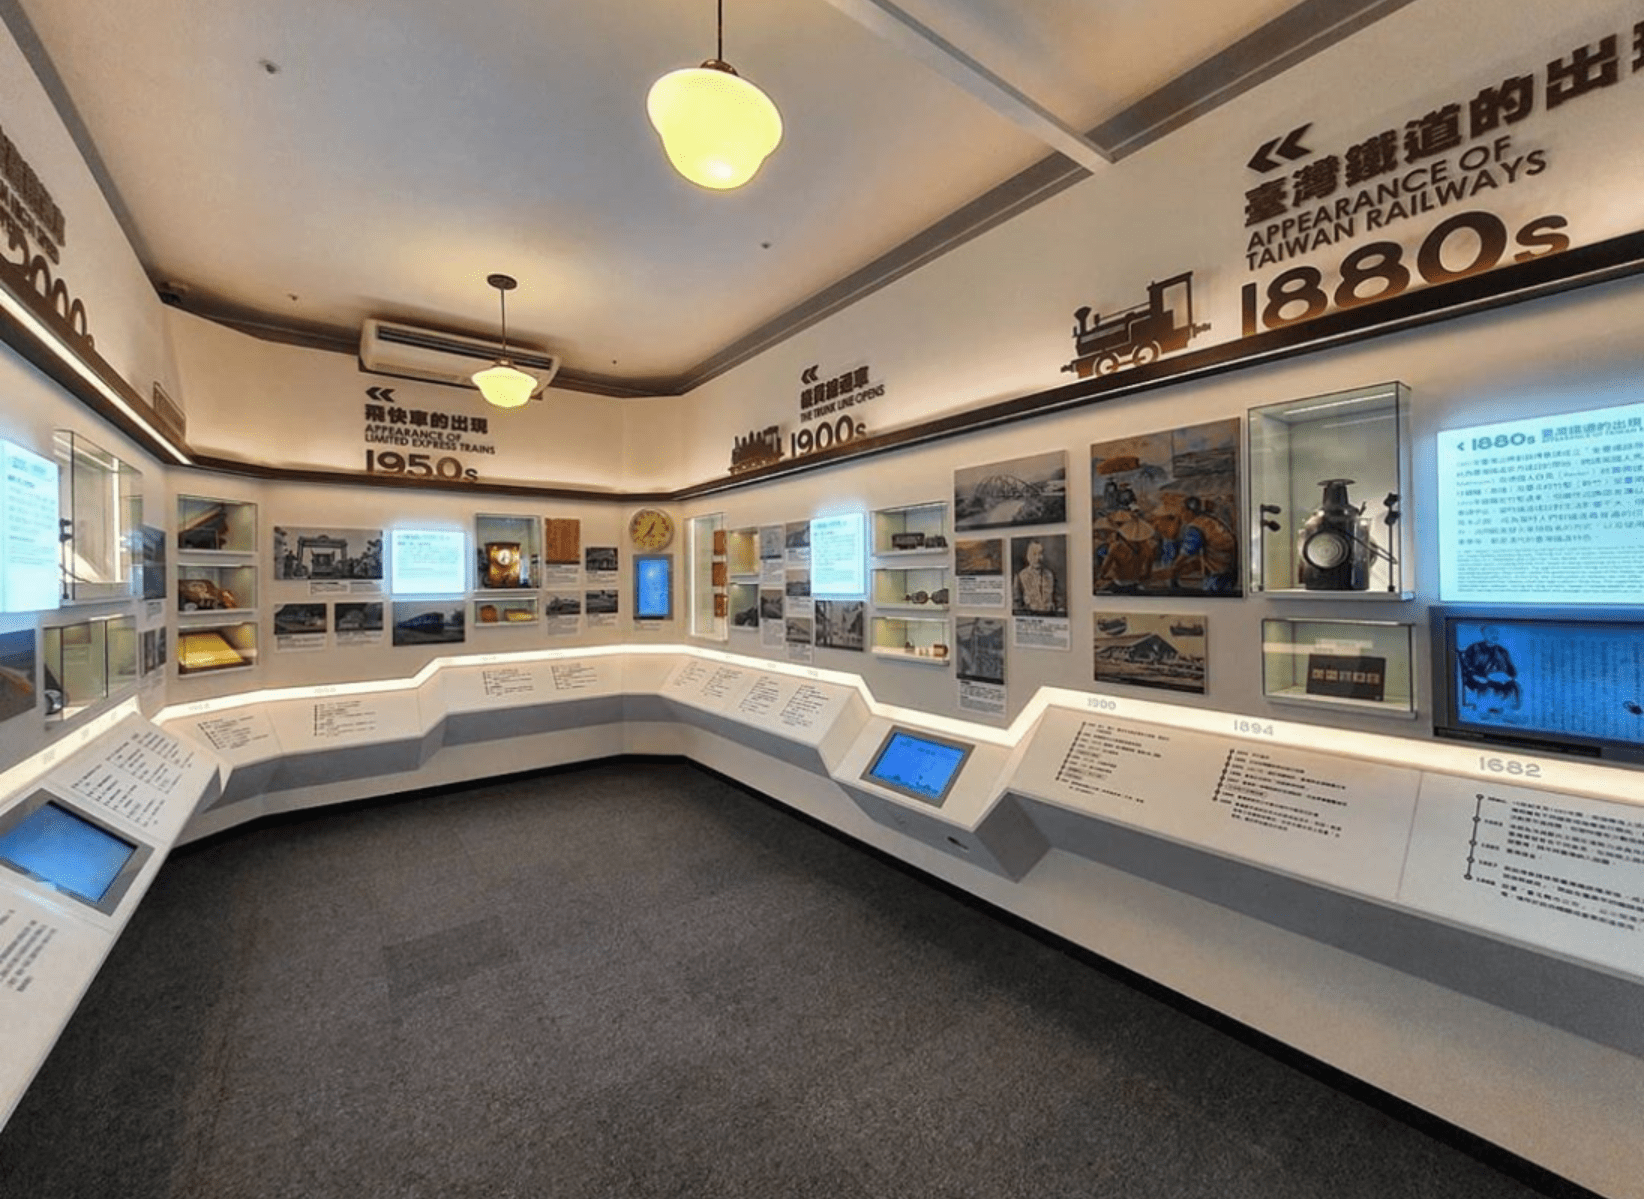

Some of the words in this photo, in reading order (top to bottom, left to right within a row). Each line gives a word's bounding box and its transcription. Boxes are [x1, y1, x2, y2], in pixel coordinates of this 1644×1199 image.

[1245, 20, 1644, 228] 臺灣鐵道的出
[1248, 160, 1448, 252] APPEARANCE
[1459, 136, 1512, 172] OF
[1246, 218, 1355, 271] TAIWAN
[1366, 150, 1547, 232] RAILWAYS
[1242, 210, 1570, 337] 1880s
[837, 395, 855, 411] LINE
[855, 383, 885, 404] OPENS
[365, 403, 488, 434] 飛快車的出現
[365, 424, 444, 441] APPEARANCE
[446, 433, 462, 443] OF
[365, 434, 409, 446] LIMITED
[412, 438, 457, 451] EXPRESS
[460, 443, 495, 455] TRAINS
[791, 415, 867, 458] 1900s
[1472, 432, 1536, 451] 1880s
[366, 449, 479, 482] 1950s
[1234, 719, 1274, 736] 1894
[1479, 756, 1542, 778] 1682
